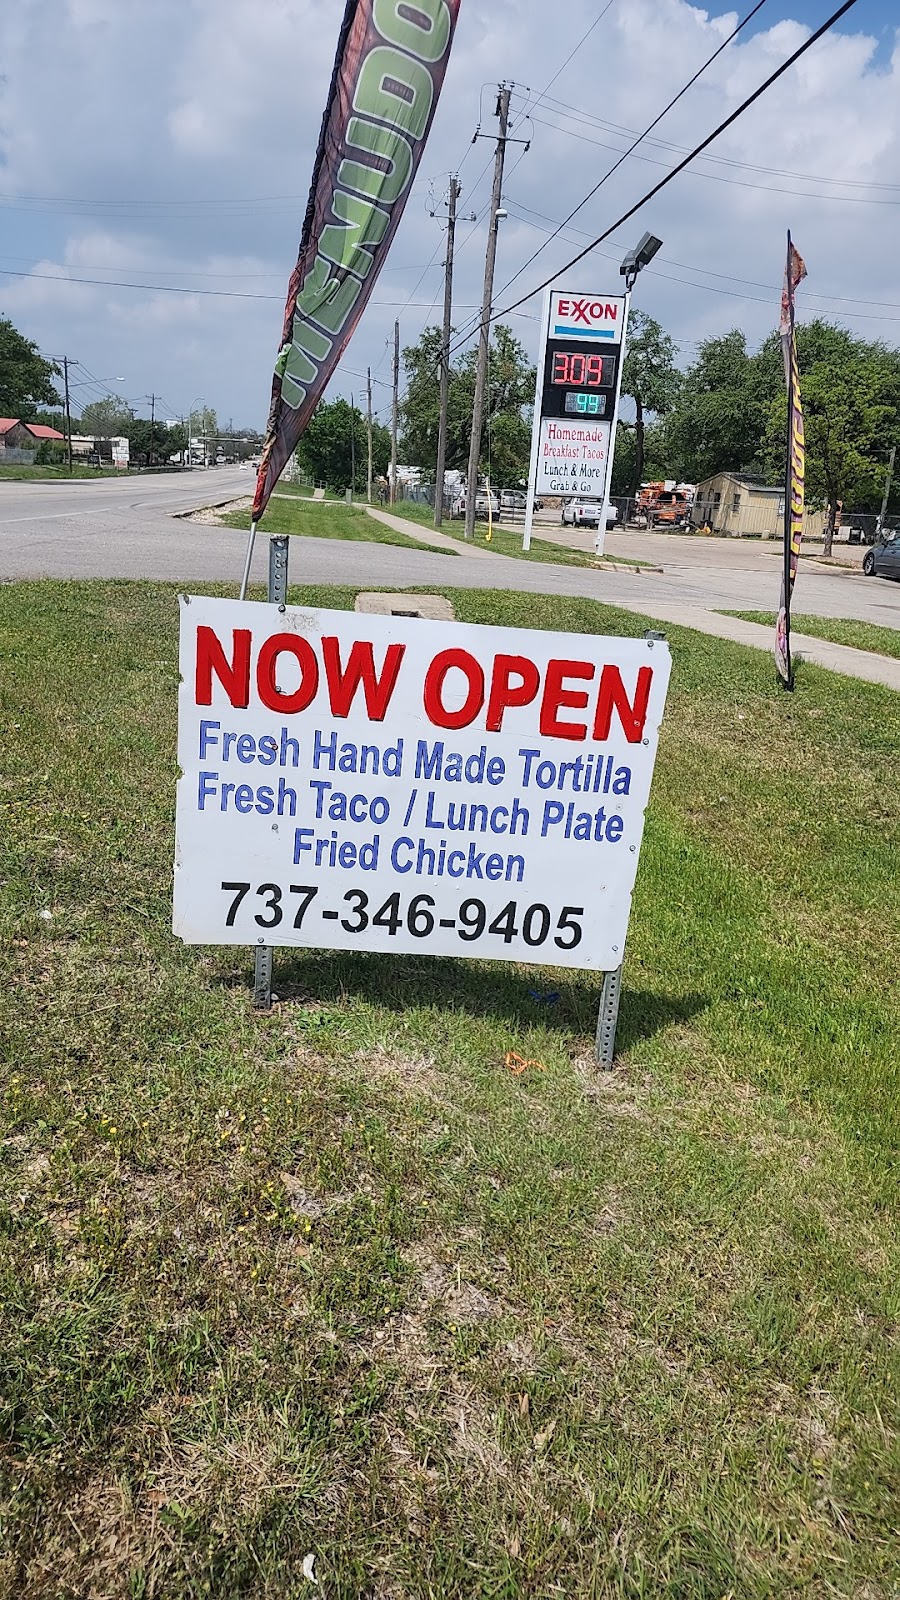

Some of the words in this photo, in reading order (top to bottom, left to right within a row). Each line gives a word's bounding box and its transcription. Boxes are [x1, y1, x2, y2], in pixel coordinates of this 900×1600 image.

[558, 299, 617, 325] EXXON
[543, 443, 580, 458] Breakfast
[582, 445, 604, 459] Tacos
[548, 424, 603, 442] Homemade
[544, 462, 568, 476] Lunch
[571, 463, 577, 477] &
[579, 463, 600, 477] More
[550, 480, 569, 490] Grab
[572, 481, 578, 491] &
[580, 482, 591, 492] Go
[195, 626, 405, 720] NOW
[424, 648, 653, 742] OPEN
[199, 720, 299, 767] Fresh
[313, 730, 404, 777] Hand
[415, 740, 505, 785] Made
[518, 749, 631, 795] Tortilla
[198, 771, 297, 816] Fresh
[310, 780, 390, 824] Taco
[404, 790, 417, 827] /
[425, 791, 529, 835] Lunch
[541, 800, 624, 843] Plate
[293, 828, 380, 870] Fried
[391, 836, 525, 881] Chicken
[222, 882, 583, 949] 737-346-9405
